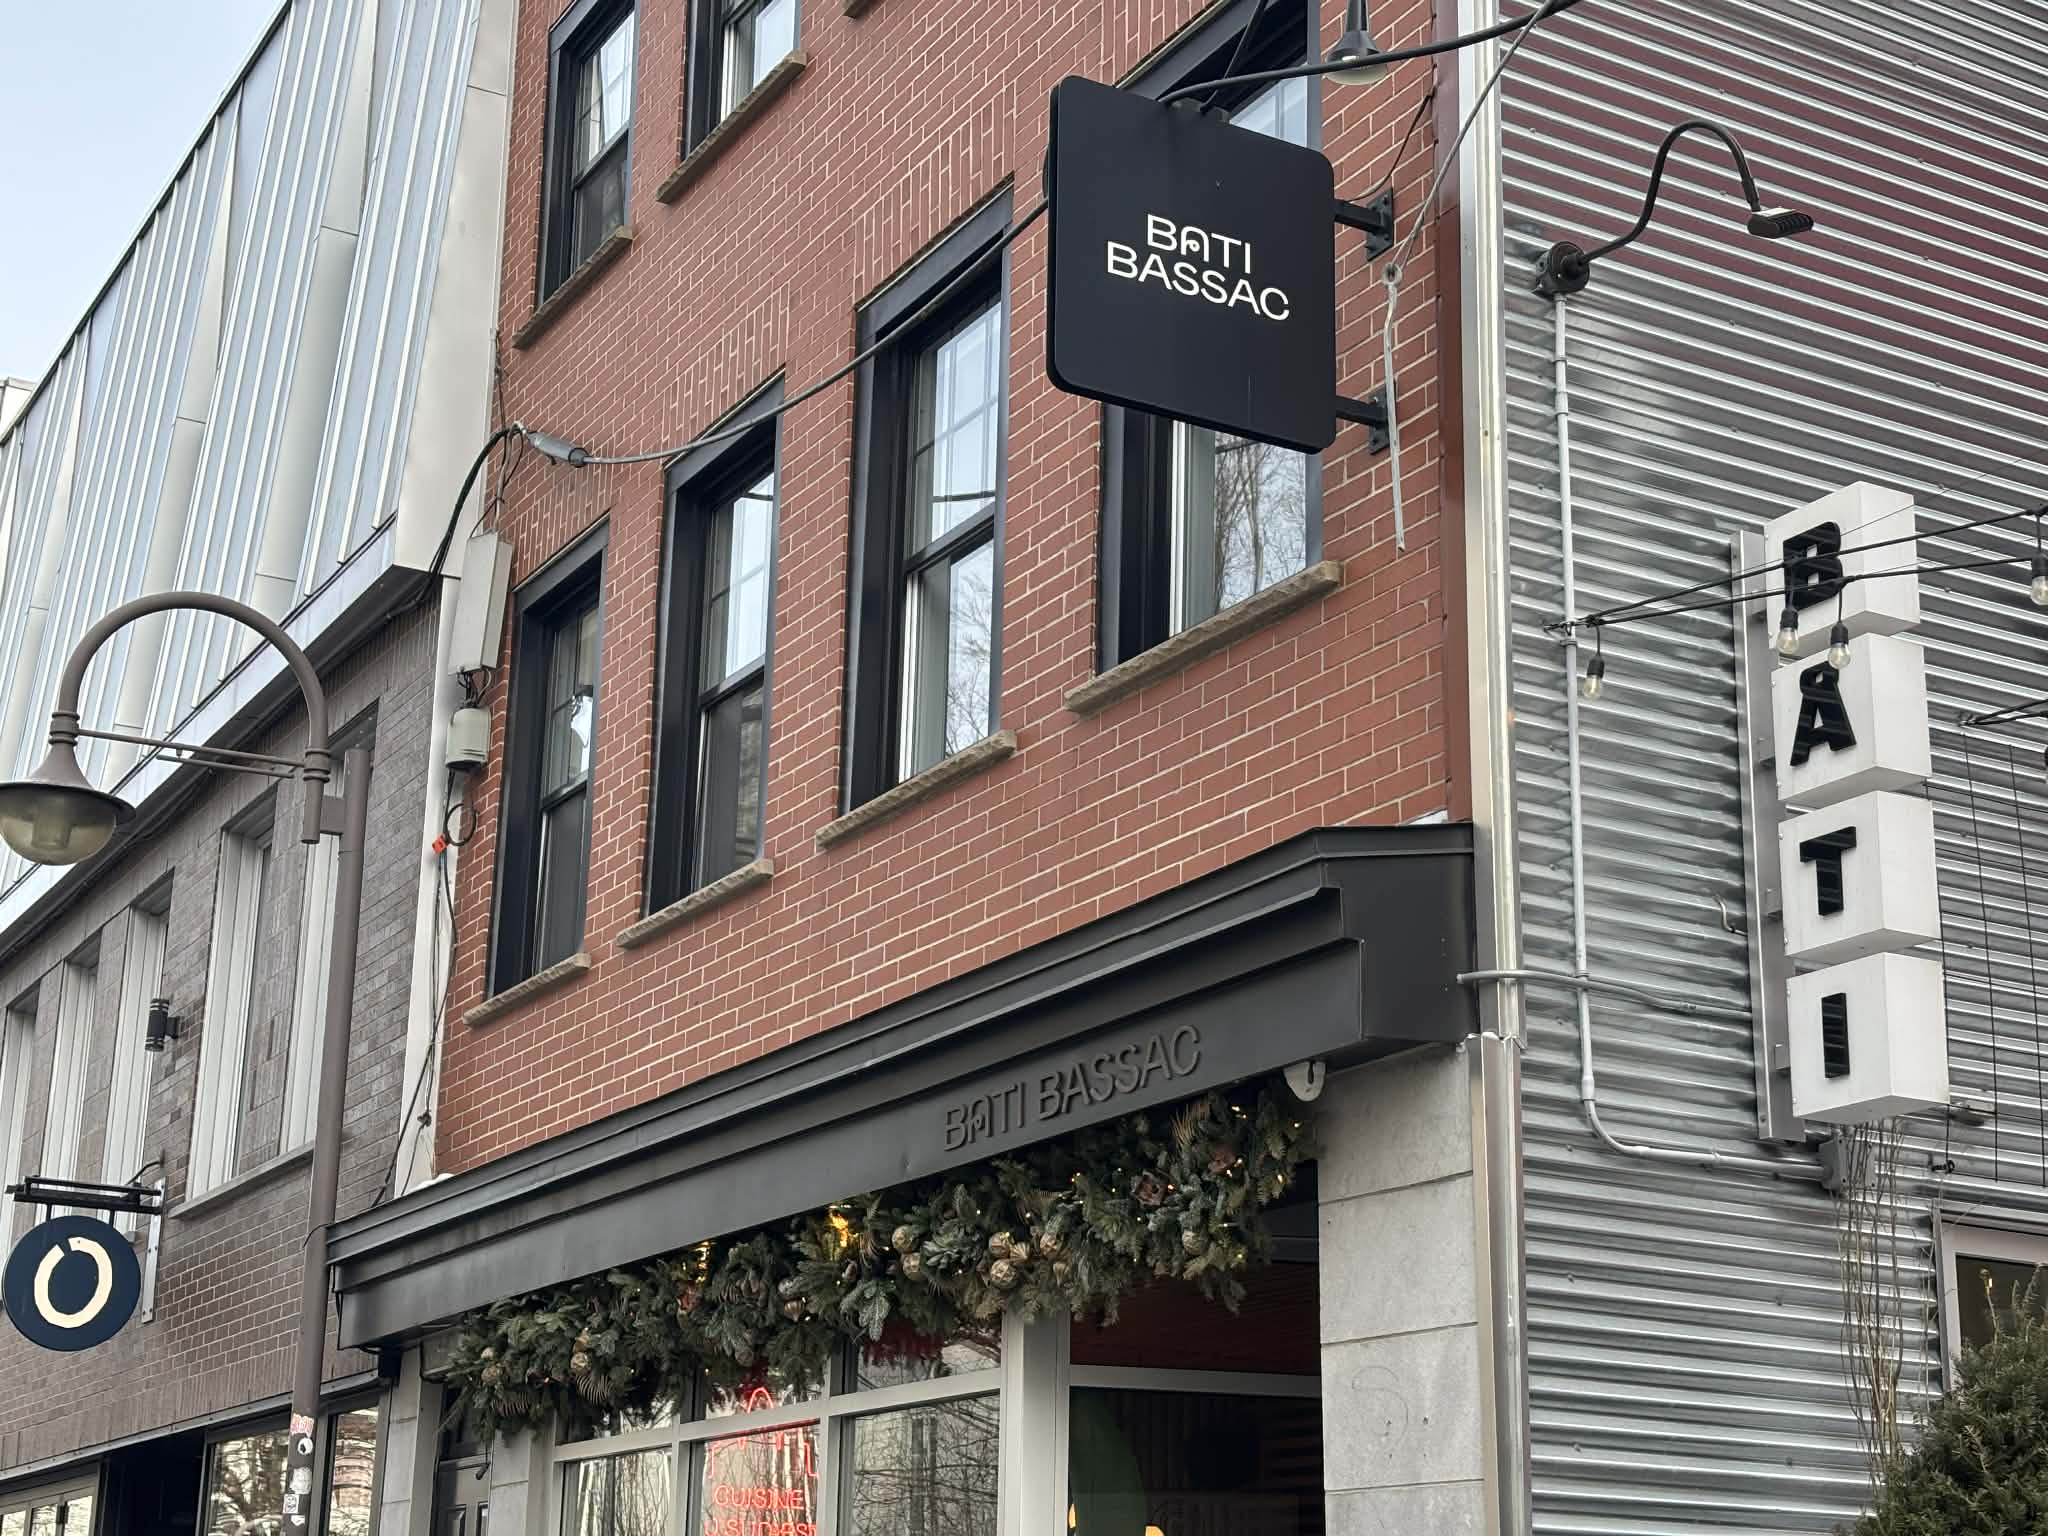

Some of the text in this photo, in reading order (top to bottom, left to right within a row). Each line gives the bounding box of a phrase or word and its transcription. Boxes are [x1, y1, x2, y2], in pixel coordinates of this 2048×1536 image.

[1147, 213, 1251, 274] BATI
[1107, 240, 1290, 321] BASSAC
[944, 1025, 1201, 1151] BATI BASSAC
[713, 1484, 805, 1511] CUISINE
